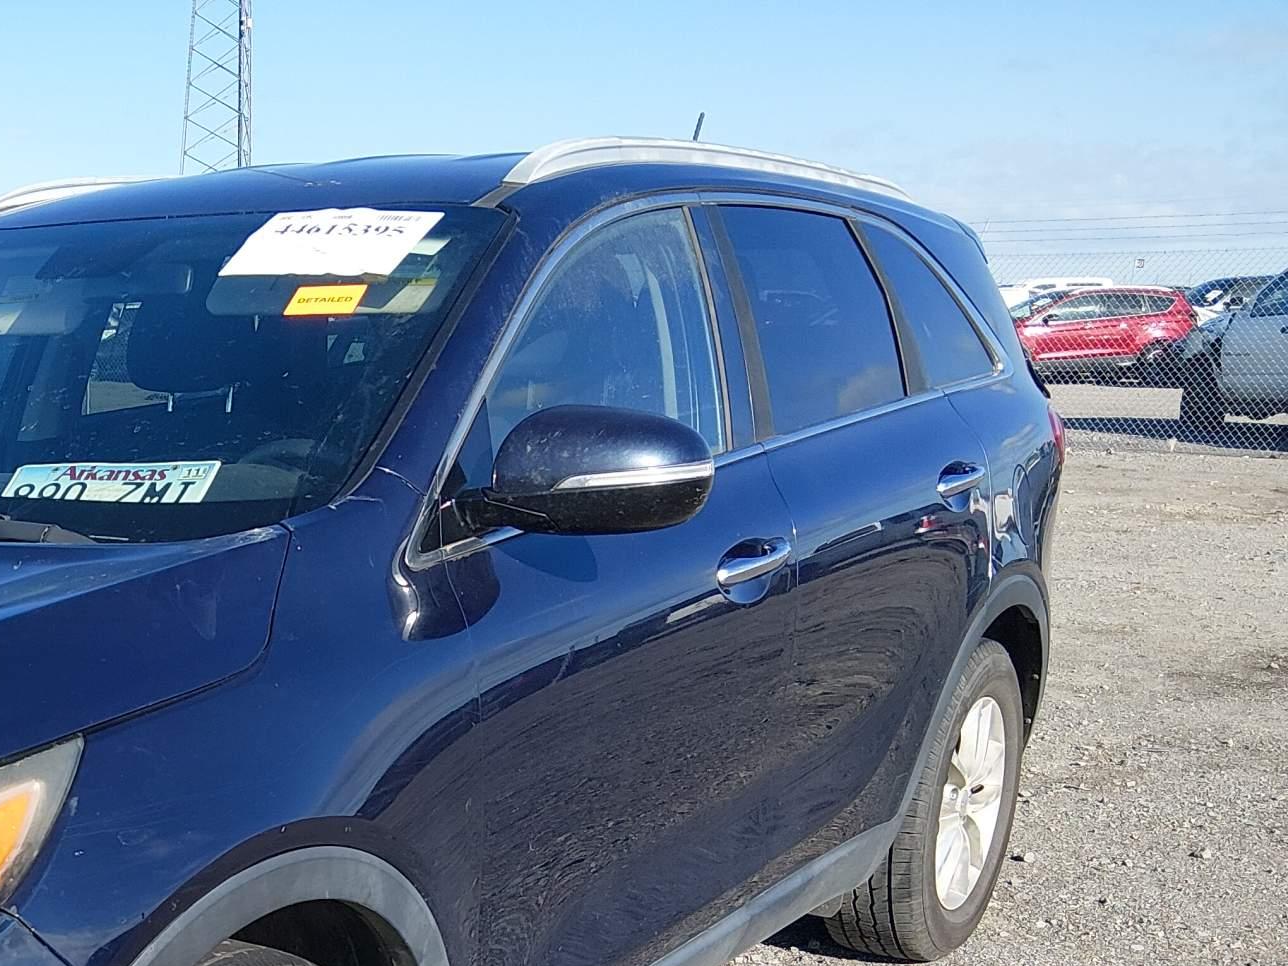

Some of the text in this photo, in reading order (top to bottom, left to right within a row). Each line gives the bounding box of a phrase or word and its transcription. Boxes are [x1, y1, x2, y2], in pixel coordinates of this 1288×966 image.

[274, 223, 407, 237] 44615395
[297, 296, 353, 304] DETAILED
[55, 465, 169, 481] Arkansas
